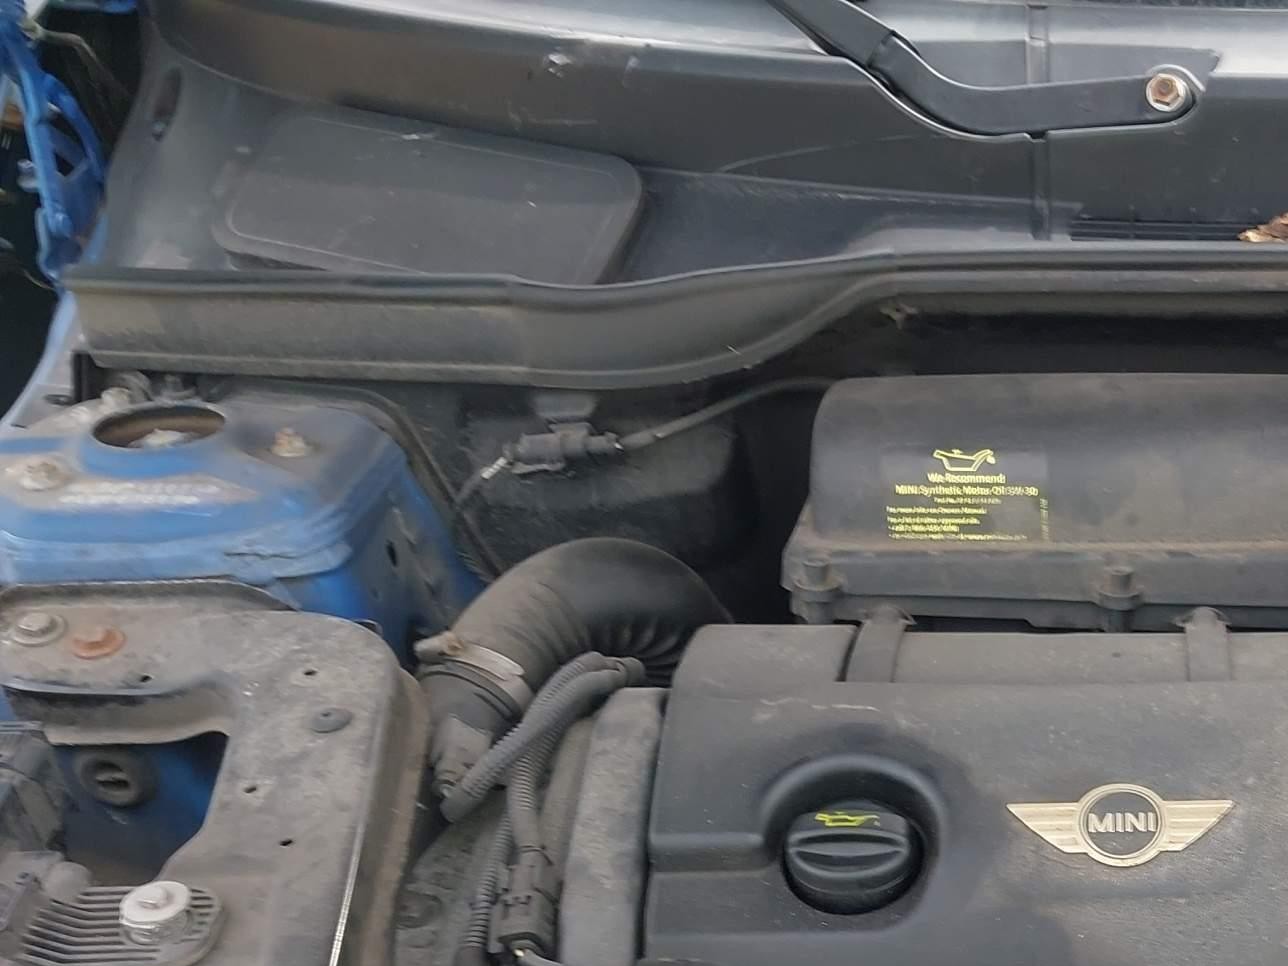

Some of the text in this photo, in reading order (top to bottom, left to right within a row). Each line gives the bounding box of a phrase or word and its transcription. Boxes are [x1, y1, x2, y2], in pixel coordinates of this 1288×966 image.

[896, 484, 918, 494] MINI
[919, 485, 962, 497] Synthetic
[962, 486, 991, 495] Motor
[1087, 812, 1157, 833] MINI
